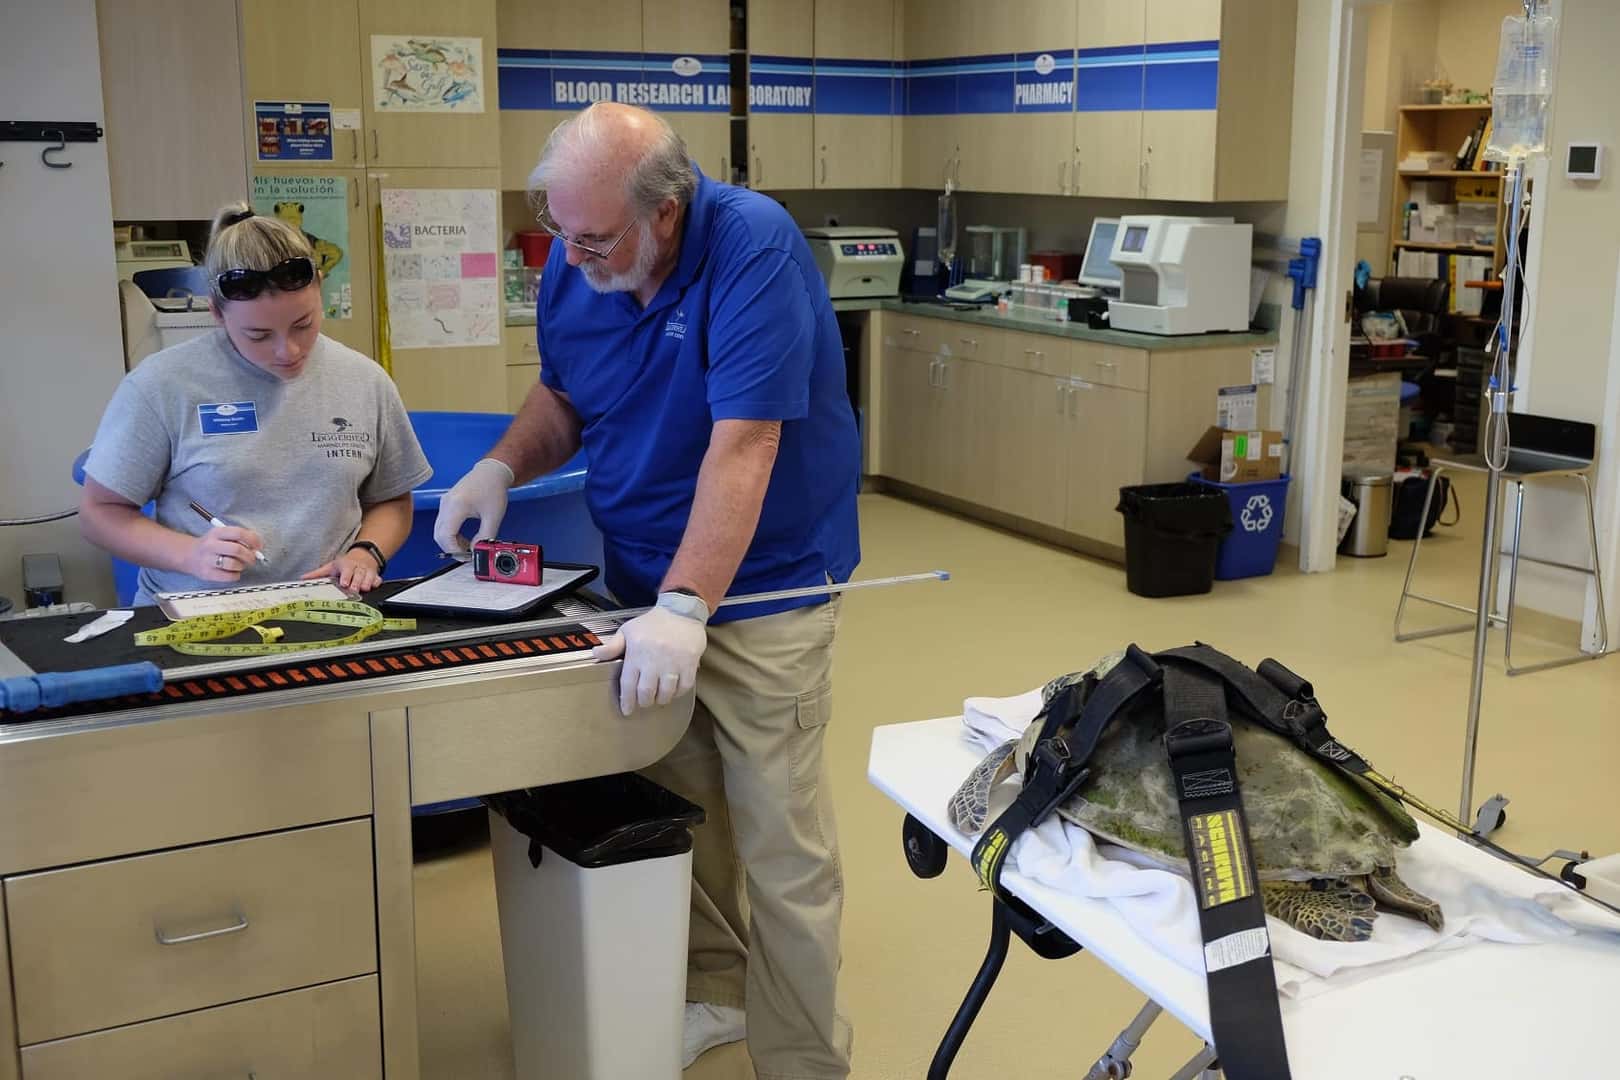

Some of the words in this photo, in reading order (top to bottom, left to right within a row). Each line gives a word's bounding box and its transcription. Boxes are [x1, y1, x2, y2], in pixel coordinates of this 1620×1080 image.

[555, 81, 612, 104] BLOOD
[616, 82, 704, 105] RESEARCH
[1015, 81, 1073, 105] PHARMACY
[273, 175, 314, 185] huevos
[319, 177, 335, 185] no
[270, 184, 280, 194] la
[414, 225, 467, 236] BACTERIA
[327, 449, 362, 459] INTERN
[1195, 817, 1217, 907] RACING
